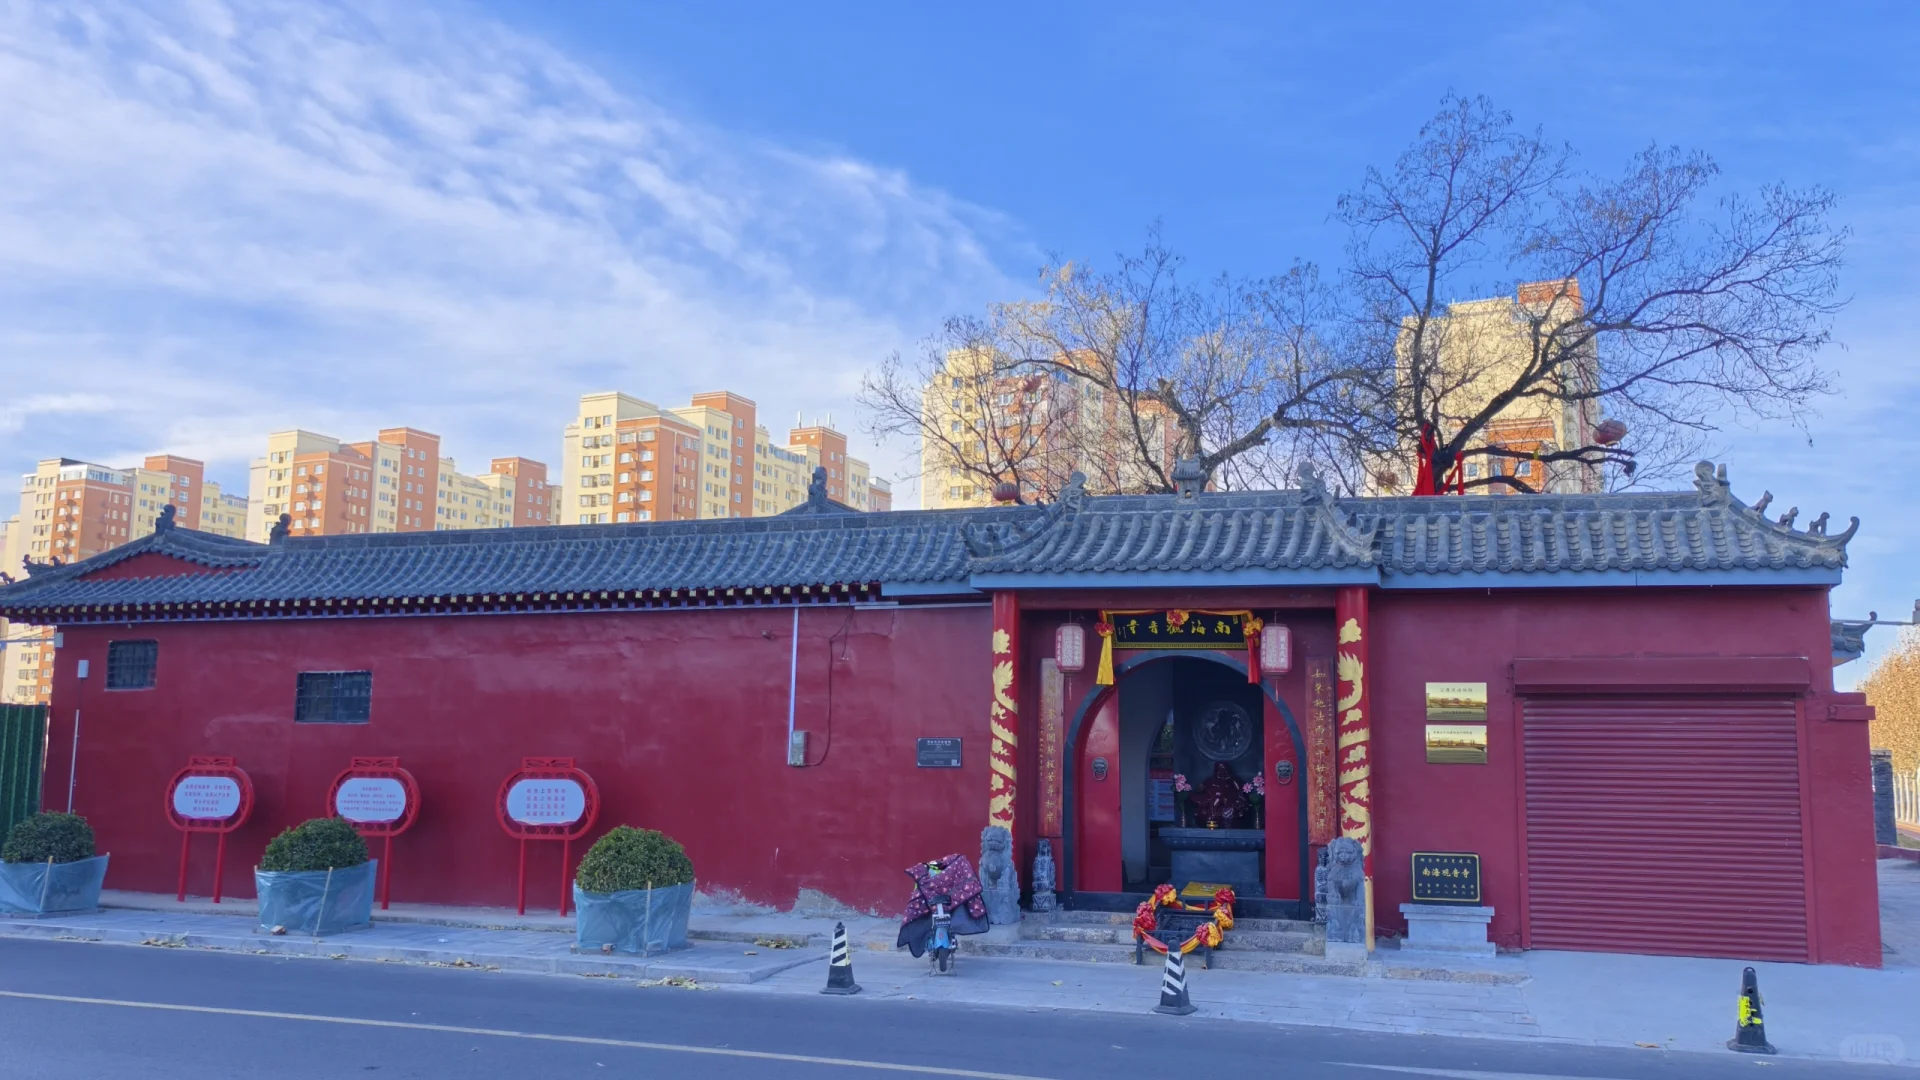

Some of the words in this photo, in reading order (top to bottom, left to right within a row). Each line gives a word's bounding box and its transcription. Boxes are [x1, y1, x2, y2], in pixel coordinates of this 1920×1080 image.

[1422, 867, 1470, 878] 南海观音寺
